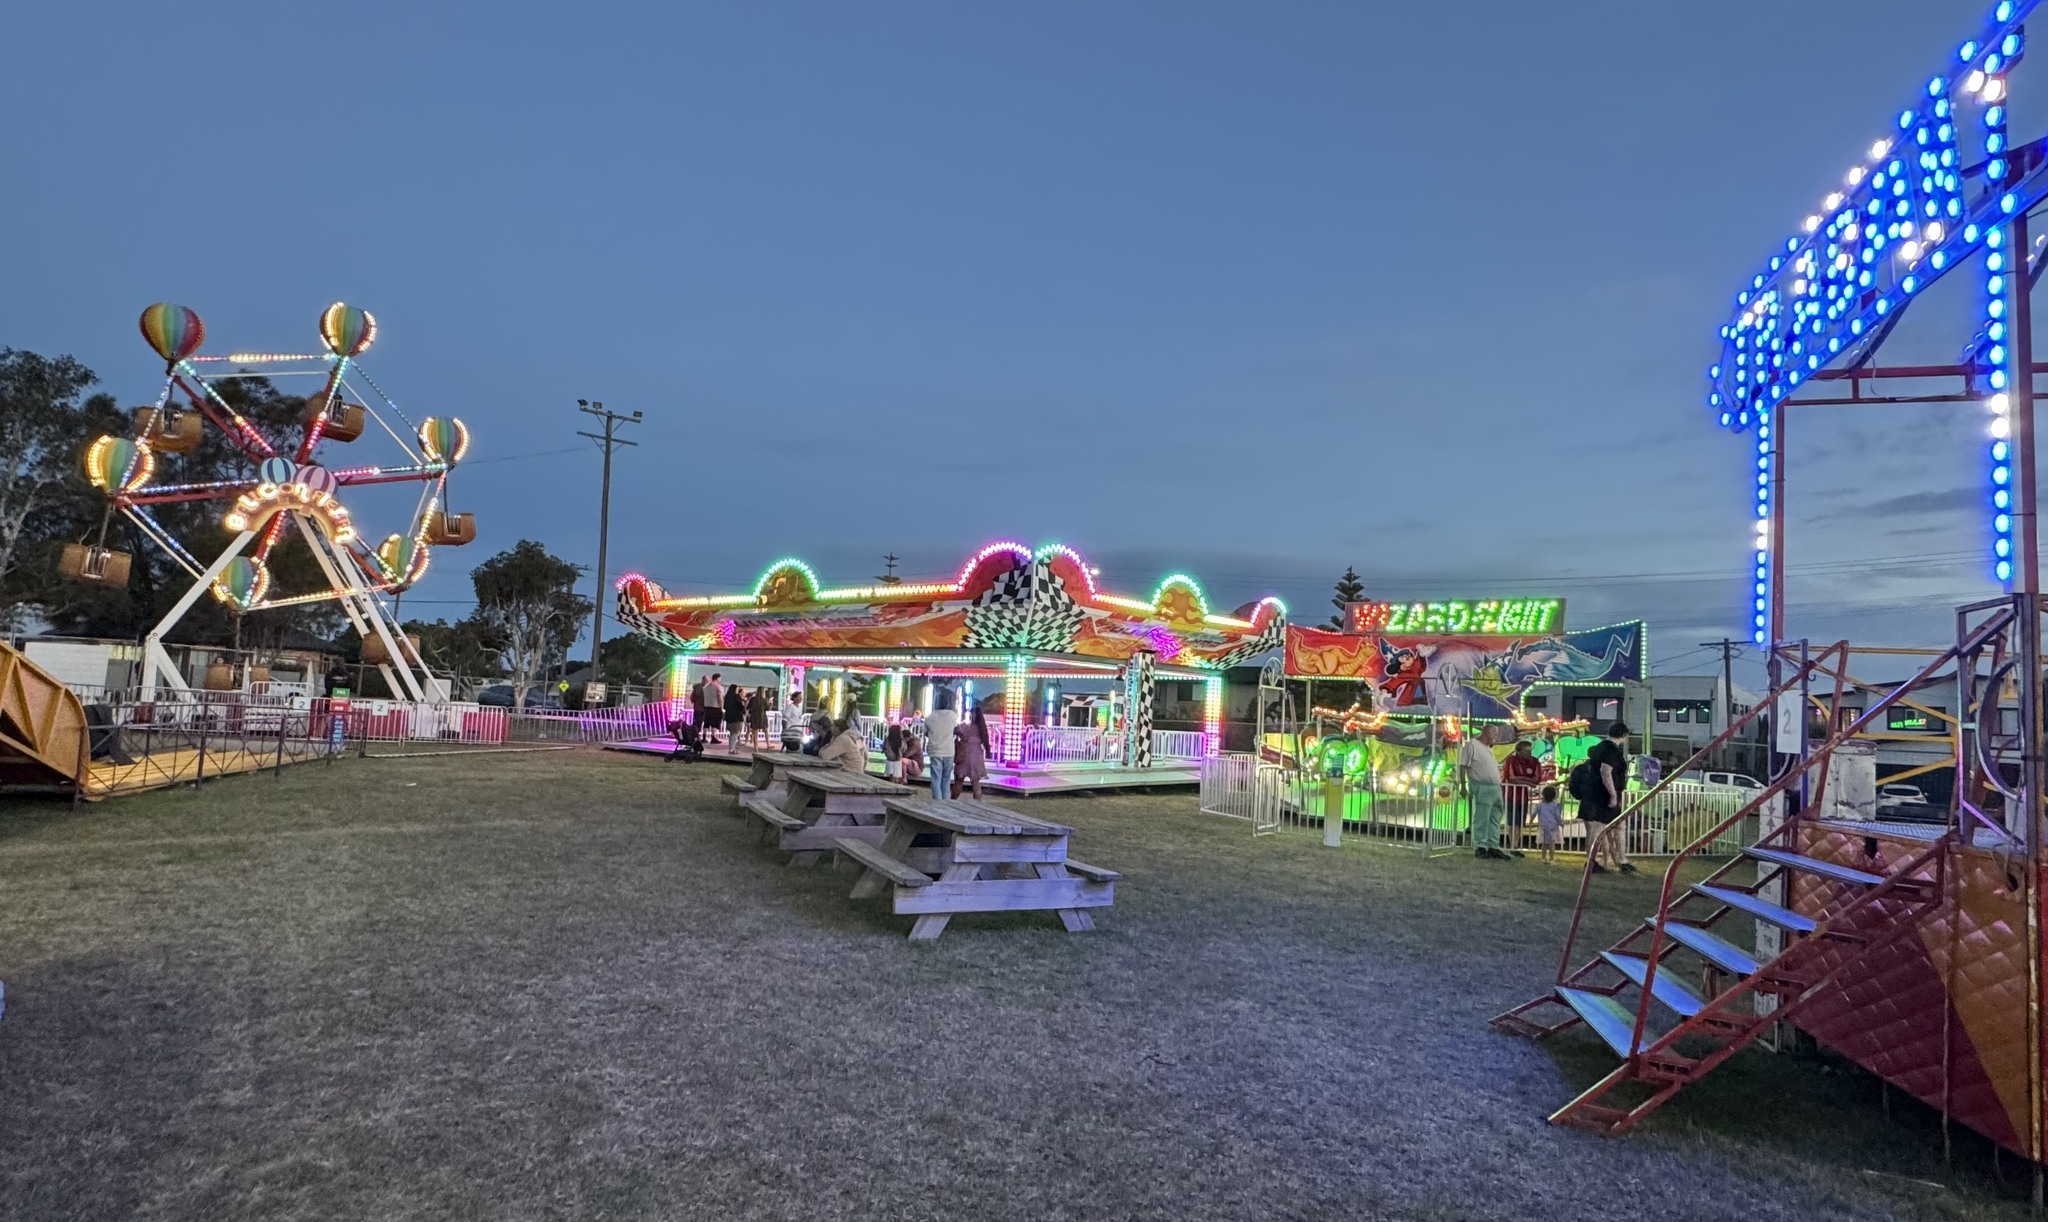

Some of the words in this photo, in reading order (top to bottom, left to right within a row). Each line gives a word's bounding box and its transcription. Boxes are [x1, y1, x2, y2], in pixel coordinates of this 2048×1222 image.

[1353, 602, 1470, 632] WIZARD
[377, 704, 384, 712] 2
[1782, 709, 1792, 735] 2
